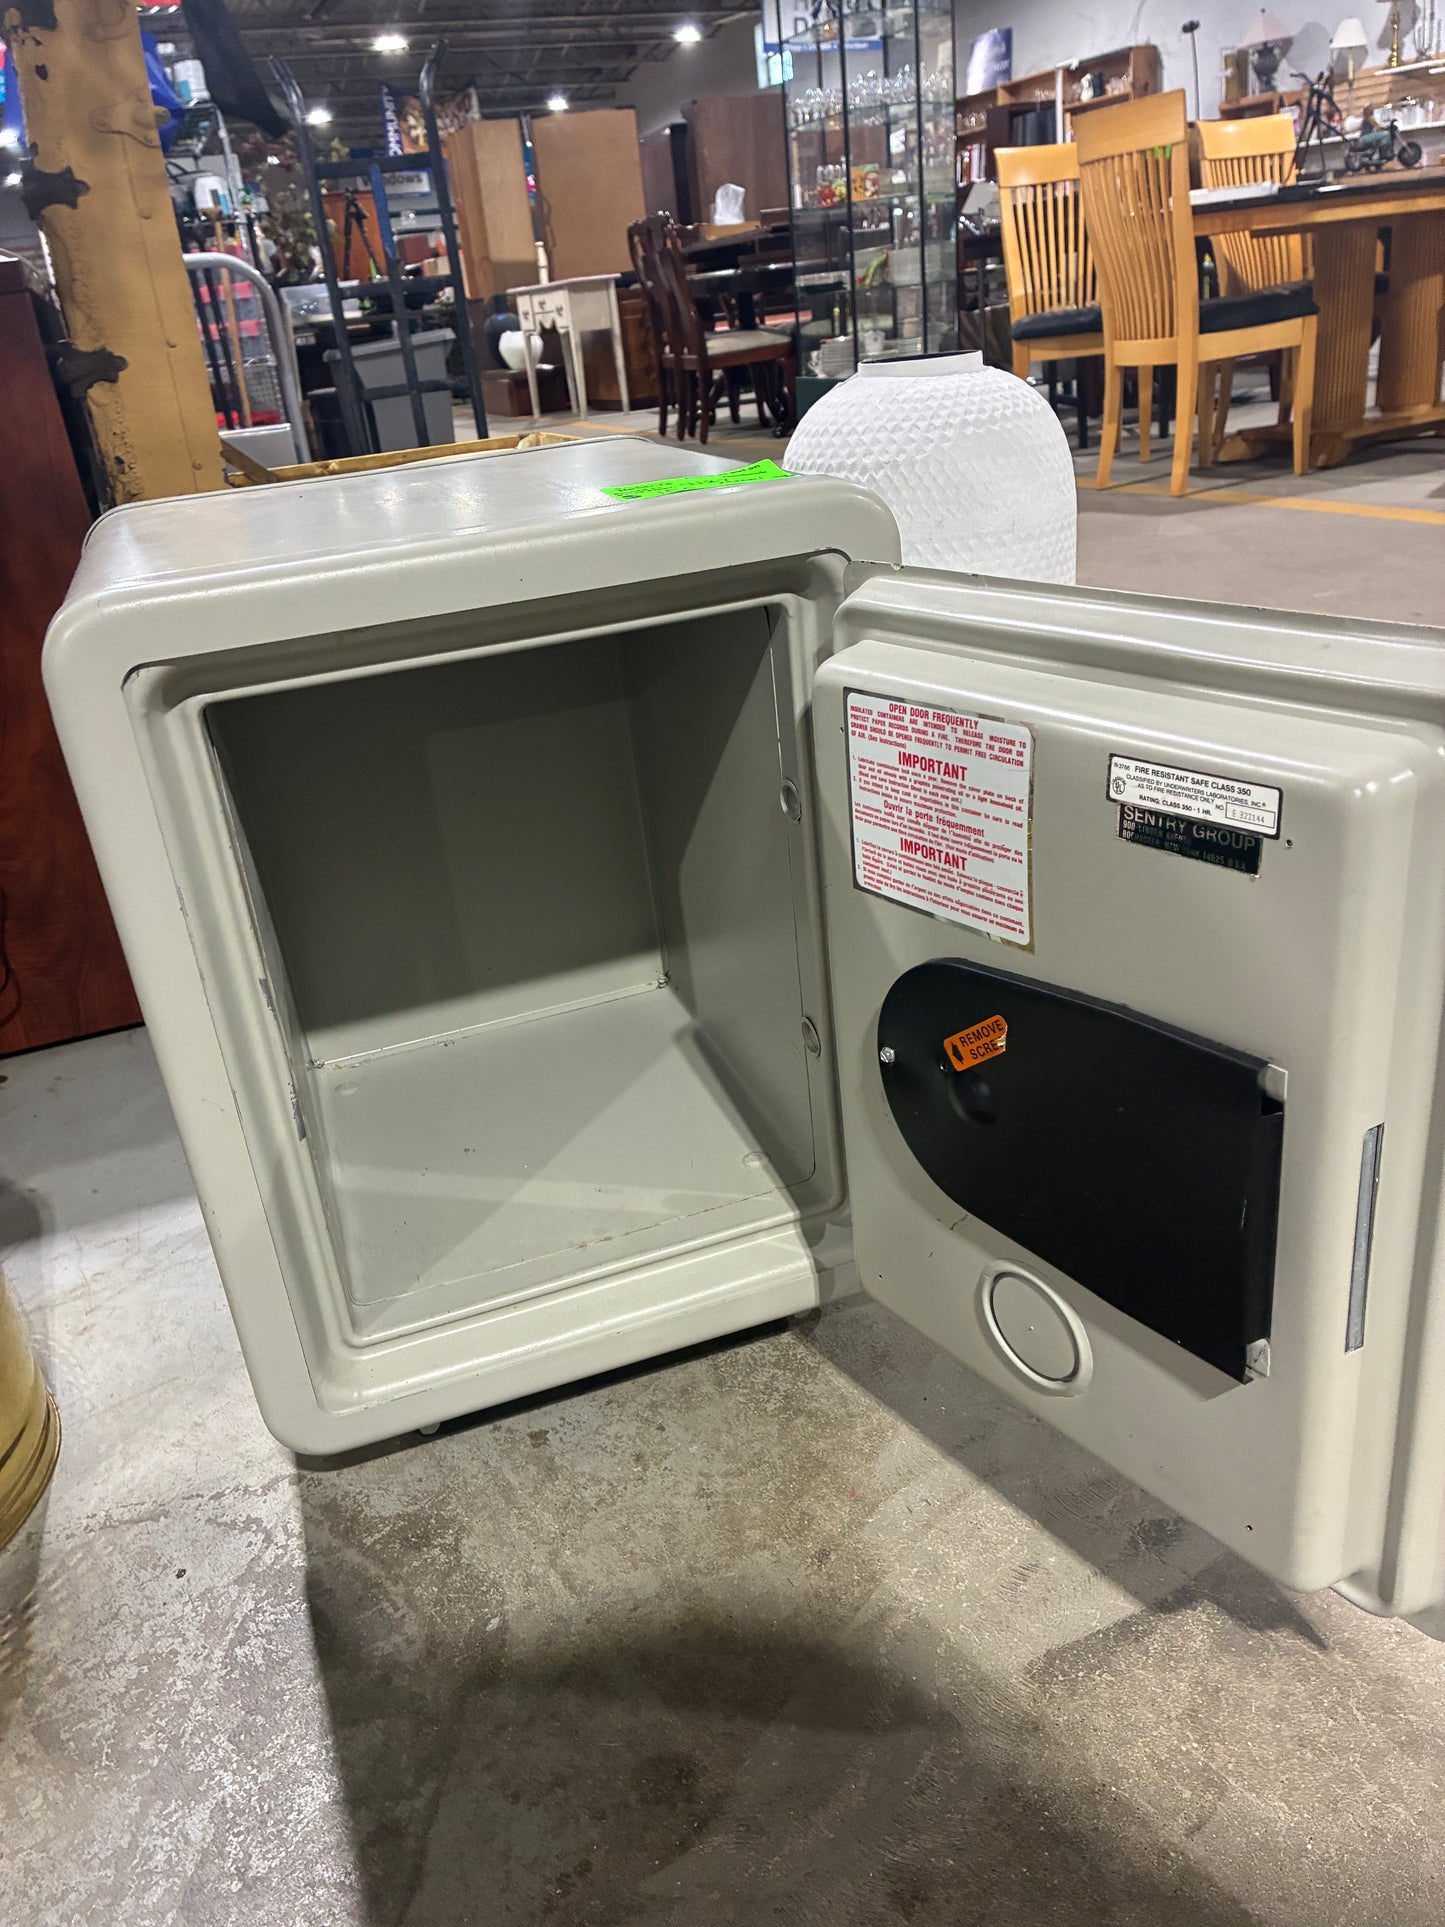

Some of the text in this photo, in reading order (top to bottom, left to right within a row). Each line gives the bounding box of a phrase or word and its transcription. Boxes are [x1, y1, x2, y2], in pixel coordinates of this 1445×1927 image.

[888, 702, 978, 730] OPEN DOOR FREQUENTLY
[898, 750, 967, 782] IMPORTANT
[1126, 774, 1155, 785] CLASSIFIED
[1164, 782, 1205, 796] UNDERWRITERS
[1135, 765, 1251, 796] FIRE RESISTANT SAFE CLASS 350
[1154, 786, 1165, 794] FIRE
[1166, 789, 1199, 801] RESISTANCE
[1200, 796, 1215, 804] ONLY
[1162, 800, 1180, 808] CLASS
[1182, 804, 1192, 812] 350
[883, 799, 984, 837] Ouvrir la porte fréquemment
[1122, 820, 1136, 831] 900
[1124, 805, 1187, 834] SENTRY
[1193, 824, 1256, 851] GROUP
[900, 837, 967, 872] IMPORTANT
[959, 1019, 1004, 1047] REMOVE
[969, 1039, 1000, 1060] SCRE
